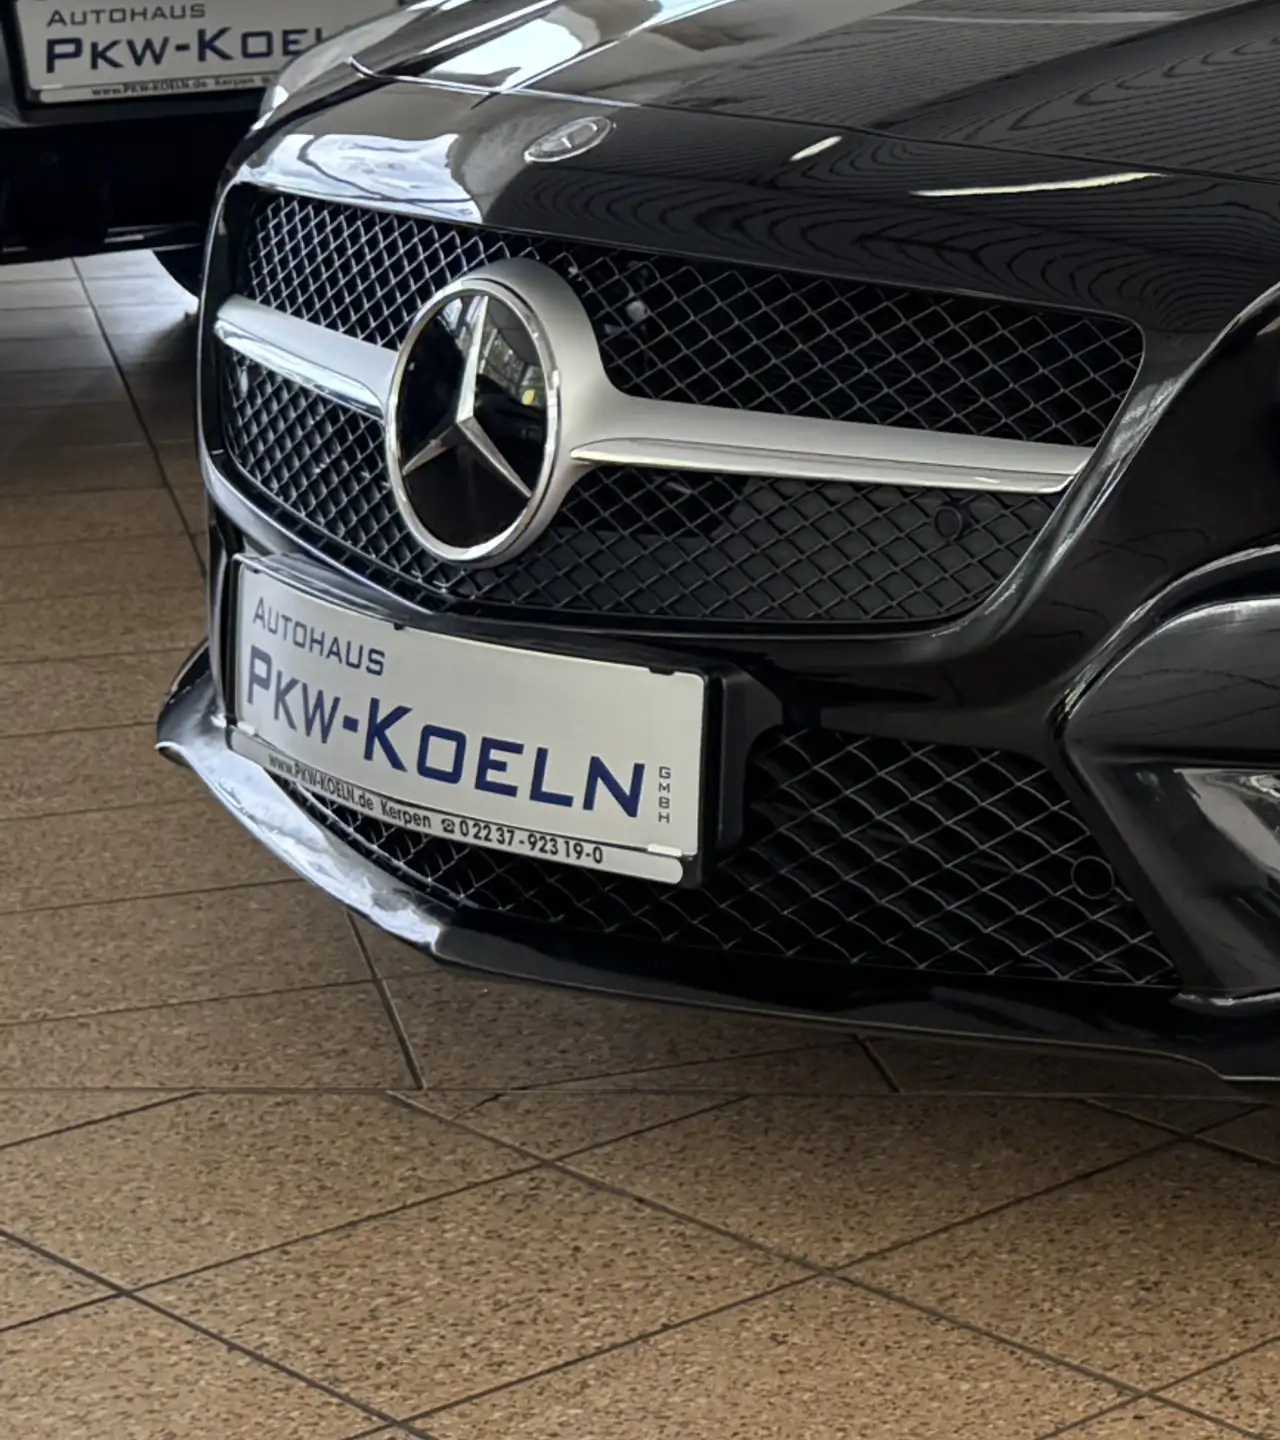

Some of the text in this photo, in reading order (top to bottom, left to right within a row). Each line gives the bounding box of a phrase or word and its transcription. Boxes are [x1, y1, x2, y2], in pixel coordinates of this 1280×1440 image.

[46, 3, 206, 28] AUTOHAUS
[46, 26, 323, 74] PKW-KOE
[253, 596, 386, 677] AUTOHAUS
[246, 644, 646, 819] PKW-KOELN
[268, 753, 374, 811] www.PKW-KOELN.de
[380, 795, 432, 829] Kerpen
